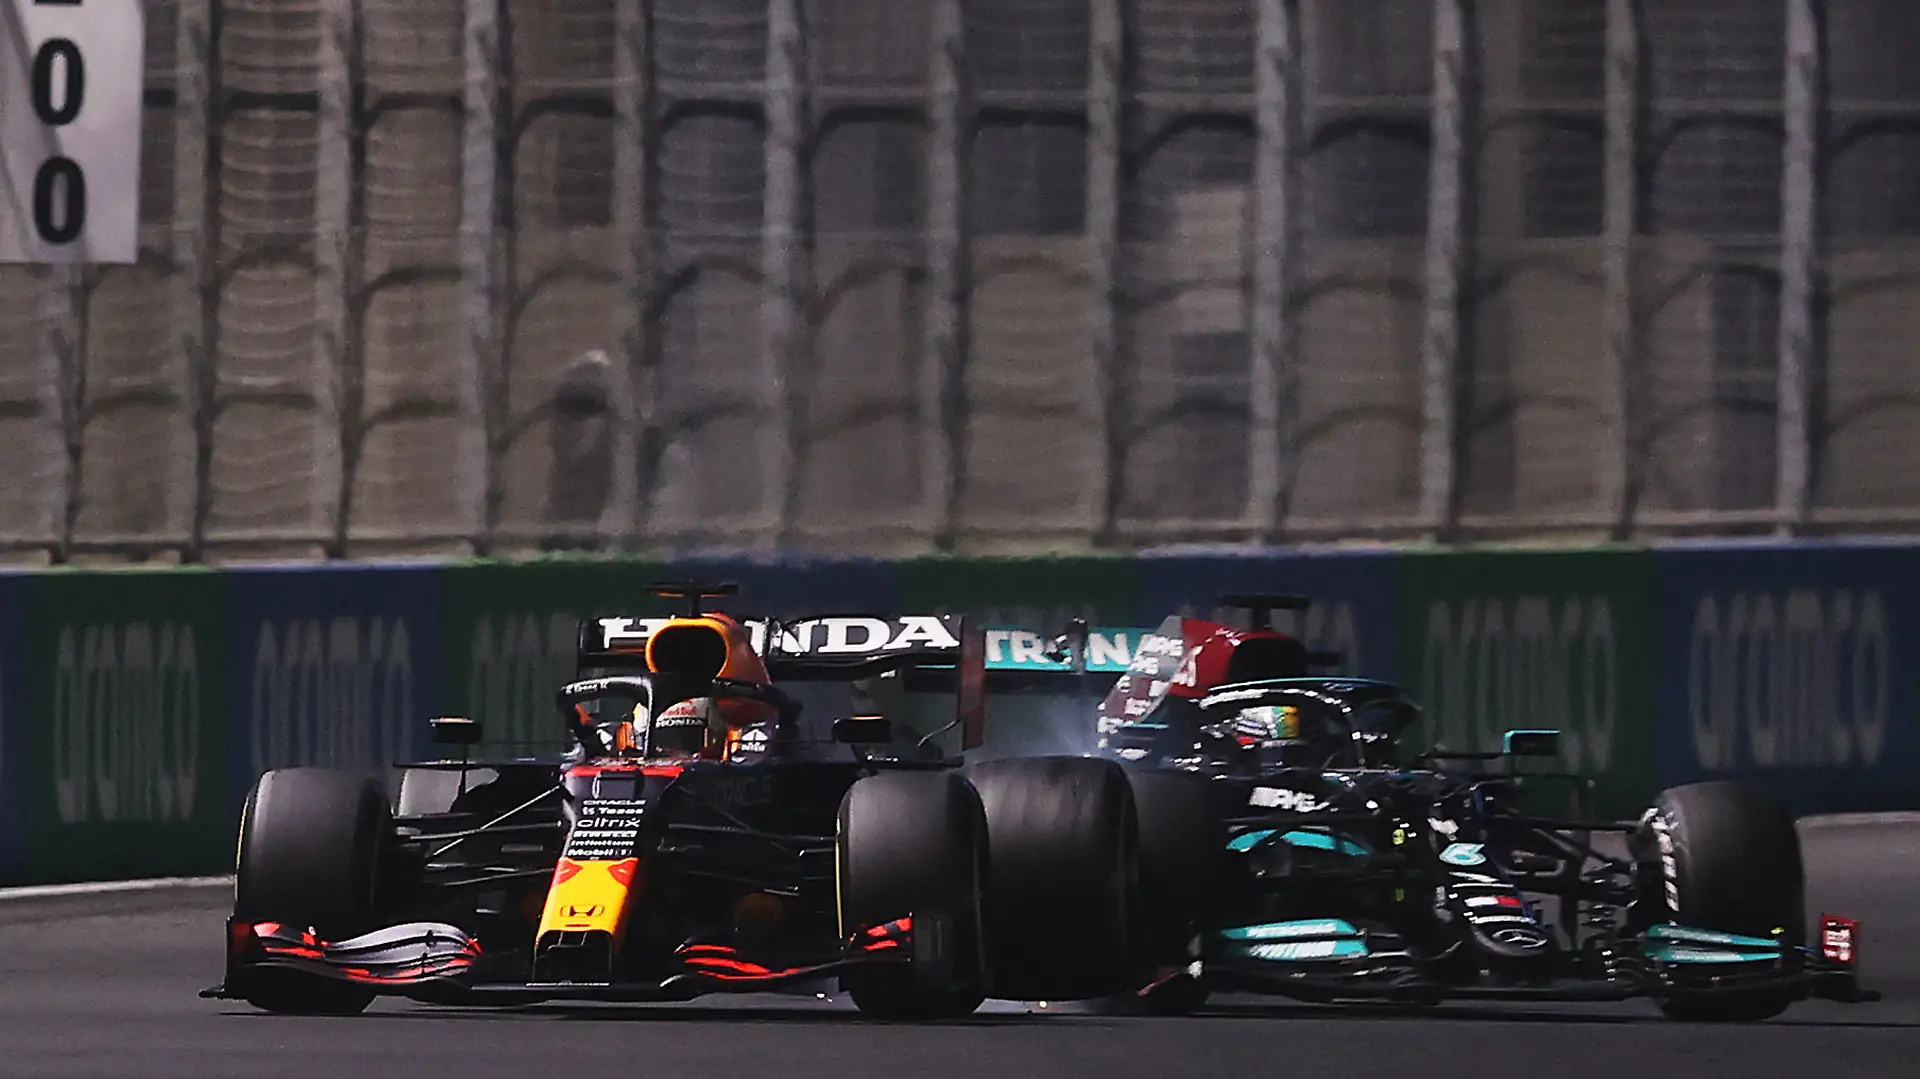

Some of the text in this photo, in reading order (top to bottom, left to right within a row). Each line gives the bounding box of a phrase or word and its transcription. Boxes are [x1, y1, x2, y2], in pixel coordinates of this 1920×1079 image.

[32, 0, 86, 245] 00
[598, 615, 960, 657] HNDA
[1686, 591, 1890, 769] aramco
[54, 619, 199, 823] aramco
[655, 717, 704, 728] HONDA
[577, 817, 641, 828] citrix
[567, 848, 614, 856] Mobil
